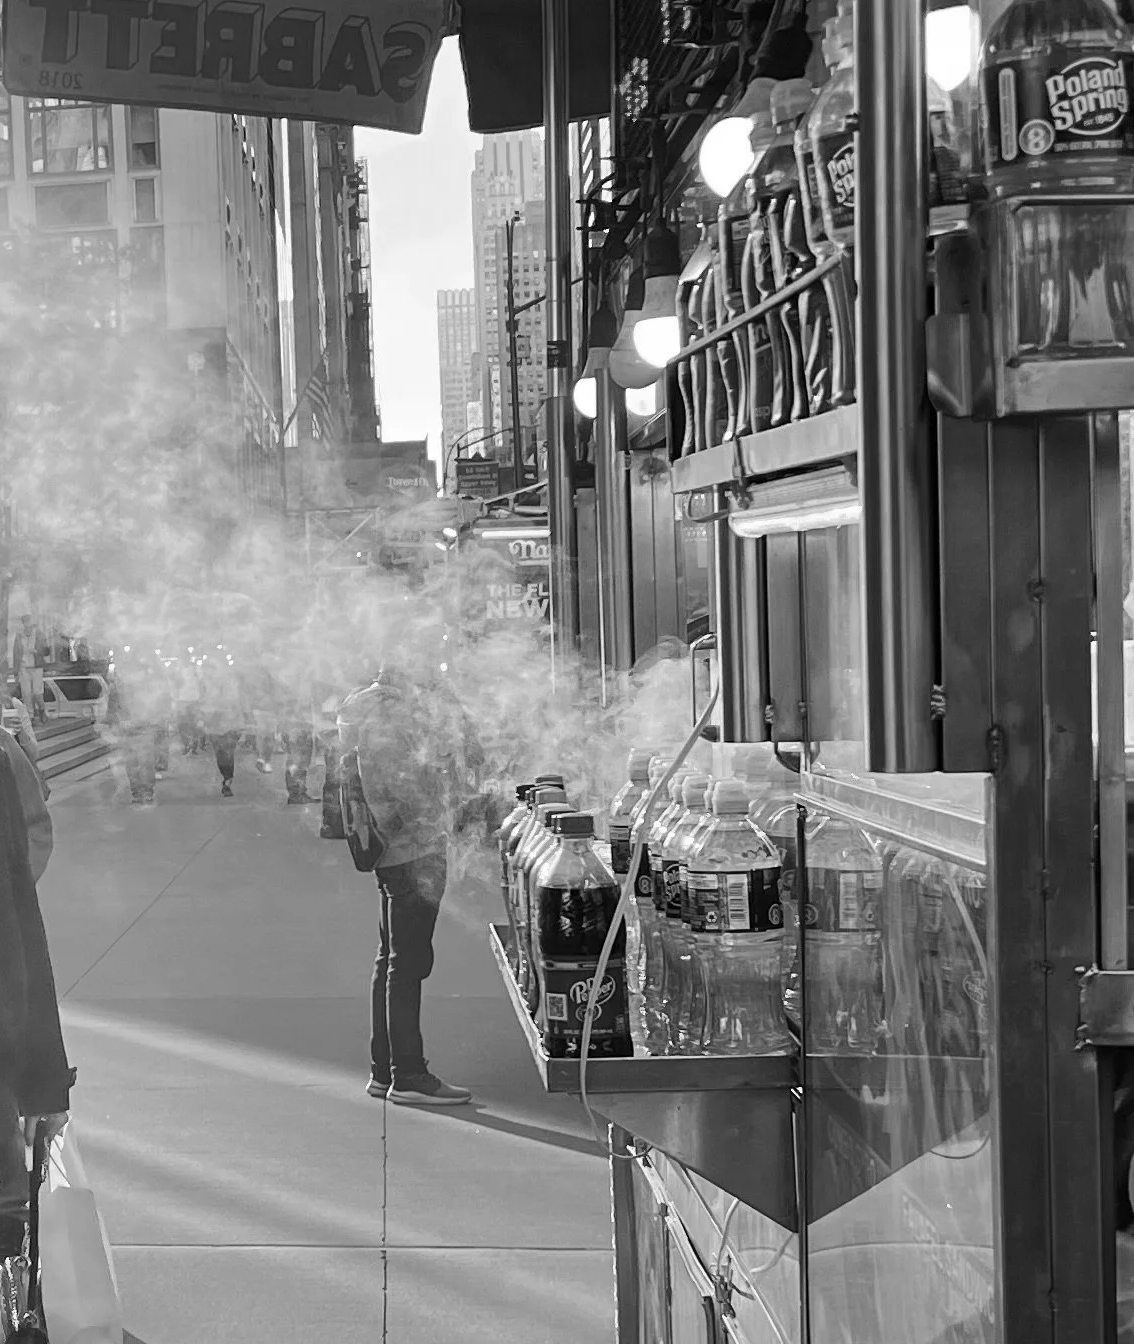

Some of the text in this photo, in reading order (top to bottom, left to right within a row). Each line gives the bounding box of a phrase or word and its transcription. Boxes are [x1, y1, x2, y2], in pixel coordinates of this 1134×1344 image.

[1046, 60, 1125, 108] Poland
[1050, 87, 1128, 131] Spring
[486, 584, 523, 597] THE
[486, 598, 550, 619] NEW
